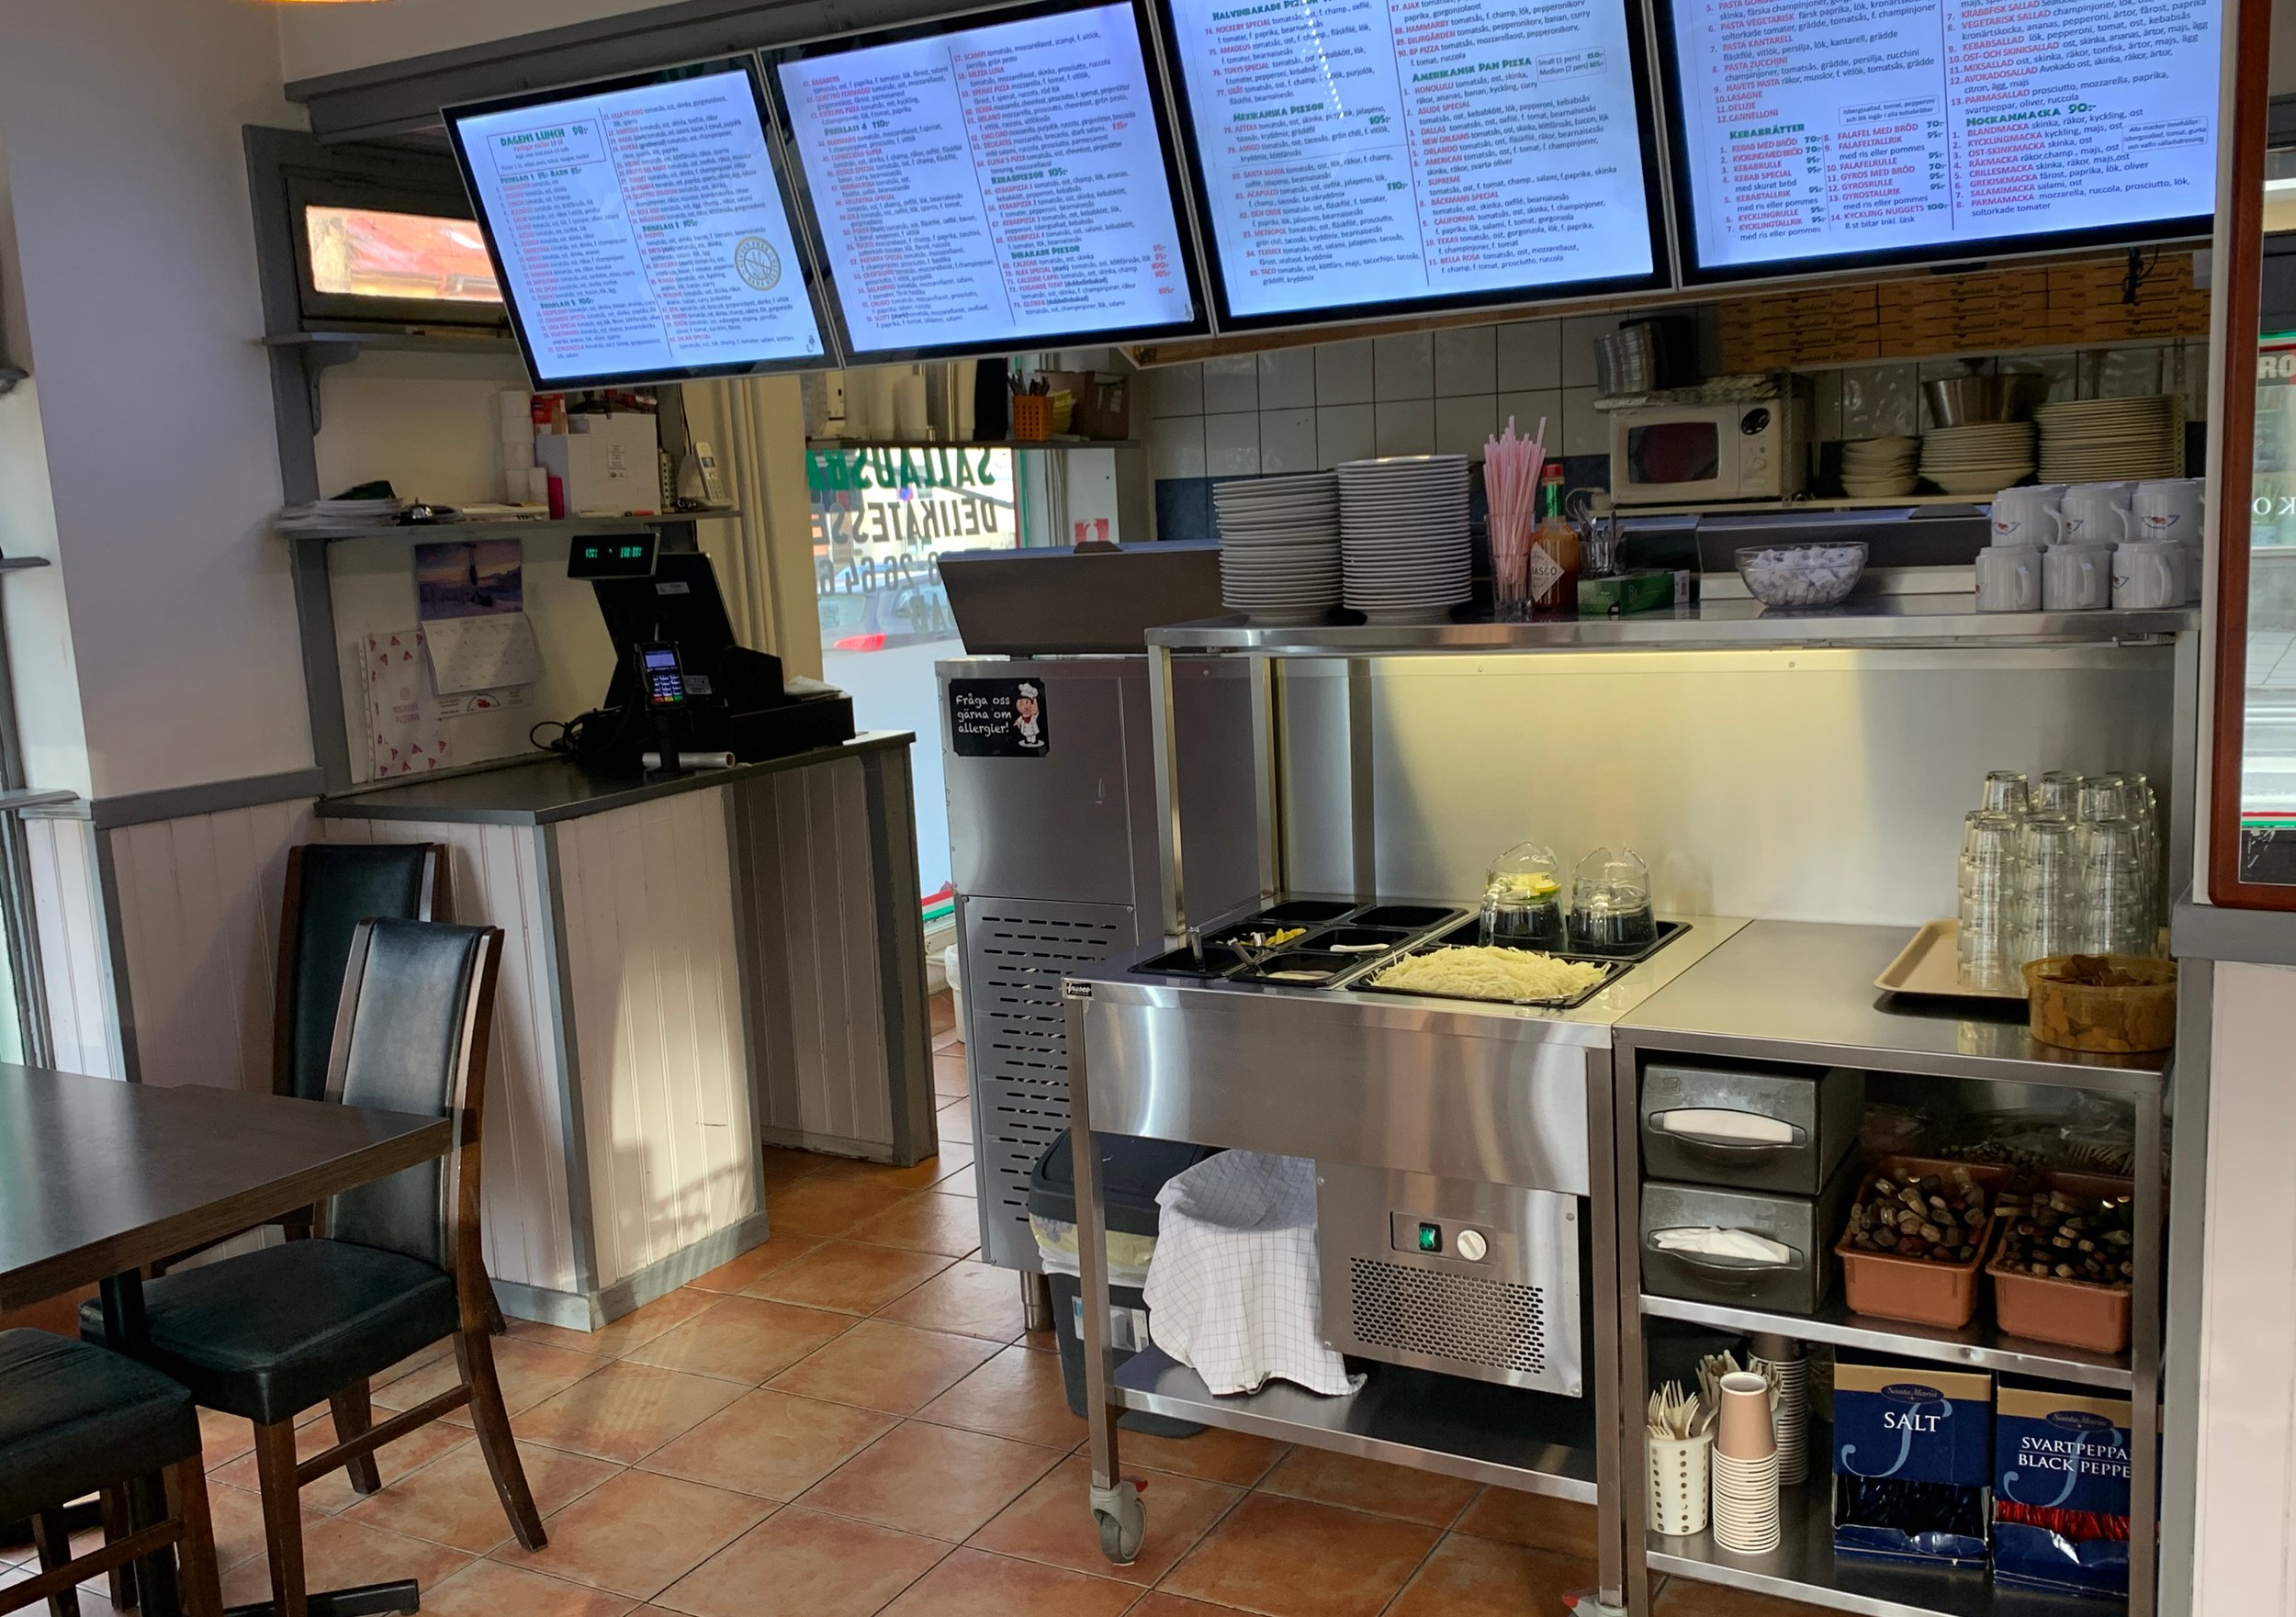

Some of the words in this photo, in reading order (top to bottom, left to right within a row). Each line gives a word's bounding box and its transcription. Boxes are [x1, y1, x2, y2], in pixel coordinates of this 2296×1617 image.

[1962, 14, 2014, 29] VEGETARISK
[2017, 8, 2051, 21] SALLAD
[2053, 0, 2117, 17] champinjoner,
[1962, 35, 2025, 51] KEBABSALLAD
[2028, 31, 2044, 42] lök,
[2046, 26, 2095, 40] pepperoni,
[2097, 20, 2127, 32] tomat,
[2129, 17, 2146, 28] ost,
[2148, 11, 2191, 25] kebabsås
[1983, 49, 2001, 59] OCH
[2003, 40, 2059, 56] SKINKSALLAD
[1723, 61, 1749, 72] PASTA
[1749, 56, 1788, 68] ZUCCHINI
[1964, 88, 2030, 104] PARMASALLAD
[2032, 83, 2077, 96] prosciutto,
[2080, 75, 2130, 89] mozzarella,
[2133, 71, 2168, 84] paprika,
[1965, 102, 2017, 116] svartpeppar,
[2019, 97, 2044, 108] oliver,
[2047, 93, 2078, 104] ruccola
[1926, 118, 1944, 128] 70:-
[1966, 107, 2060, 127] NOCKANMACKA
[2068, 101, 2096, 114] 90:-
[1966, 121, 2030, 137] BLANDMACKA
[2031, 118, 2061, 129] skinka,
[2063, 115, 2087, 125] räkor,
[2089, 109, 2127, 123] kyckling,
[2129, 108, 2143, 118] ost
[499, 133, 535, 146] DAGENS
[534, 128, 566, 140] LUNCH
[1729, 123, 1805, 140] KEBABRÄTTER
[1804, 134, 1822, 143] 70:-
[1837, 129, 1871, 140] FALAFEL
[1872, 126, 1893, 136] MED
[1893, 122, 1919, 132] BRÖD
[1967, 130, 2043, 147] KYCKLINGMACKA
[2043, 126, 2081, 139] kyckling,
[2083, 123, 2107, 134] majs,
[2109, 121, 2122, 130] ost
[1731, 142, 1755, 152] KEBAB
[1756, 140, 1774, 150] MED
[1775, 137, 1798, 147] BRÖD
[1824, 143, 1832, 152] 9.
[1838, 135, 1903, 150] FALAFELTALLRIK
[1827, 174, 1839, 182] 11.
[1840, 170, 1868, 181] GYROS
[1869, 168, 1889, 177] MED
[1891, 164, 1916, 174] BRÖD
[1968, 163, 2033, 177] CRILLESMACKA
[2035, 160, 2065, 171] skinka,
[2066, 157, 2090, 167] räkor,
[1734, 183, 1752, 193] med
[1753, 180, 1777, 190] skuret
[1778, 178, 1797, 187] bröd
[1970, 183, 2035, 197] SALAMIMACKA
[2037, 180, 2066, 190] salami,
[2068, 178, 2082, 186] ost
[1830, 213, 1842, 221] 14.
[1843, 208, 1883, 219] KYCKLING
[1885, 204, 1924, 215] NUGGETS
[1927, 201, 1949, 210] 100:-
[1972, 205, 2014, 217] soltorkade
[2017, 202, 2050, 212] tomater
[1844, 221, 1851, 230] 8
[1860, 219, 1879, 228] bitar
[1899, 215, 1915, 223] läsk
[955, 692, 988, 709] Fråga
[992, 696, 1010, 705] oss
[957, 709, 990, 723] gärna
[994, 711, 1012, 719] om
[958, 722, 1009, 736] allergier!
[1884, 1411, 1941, 1432] SALT
[2021, 1436, 2131, 1461] SVARTPEPPA
[2019, 1453, 2075, 1471] BLACK
